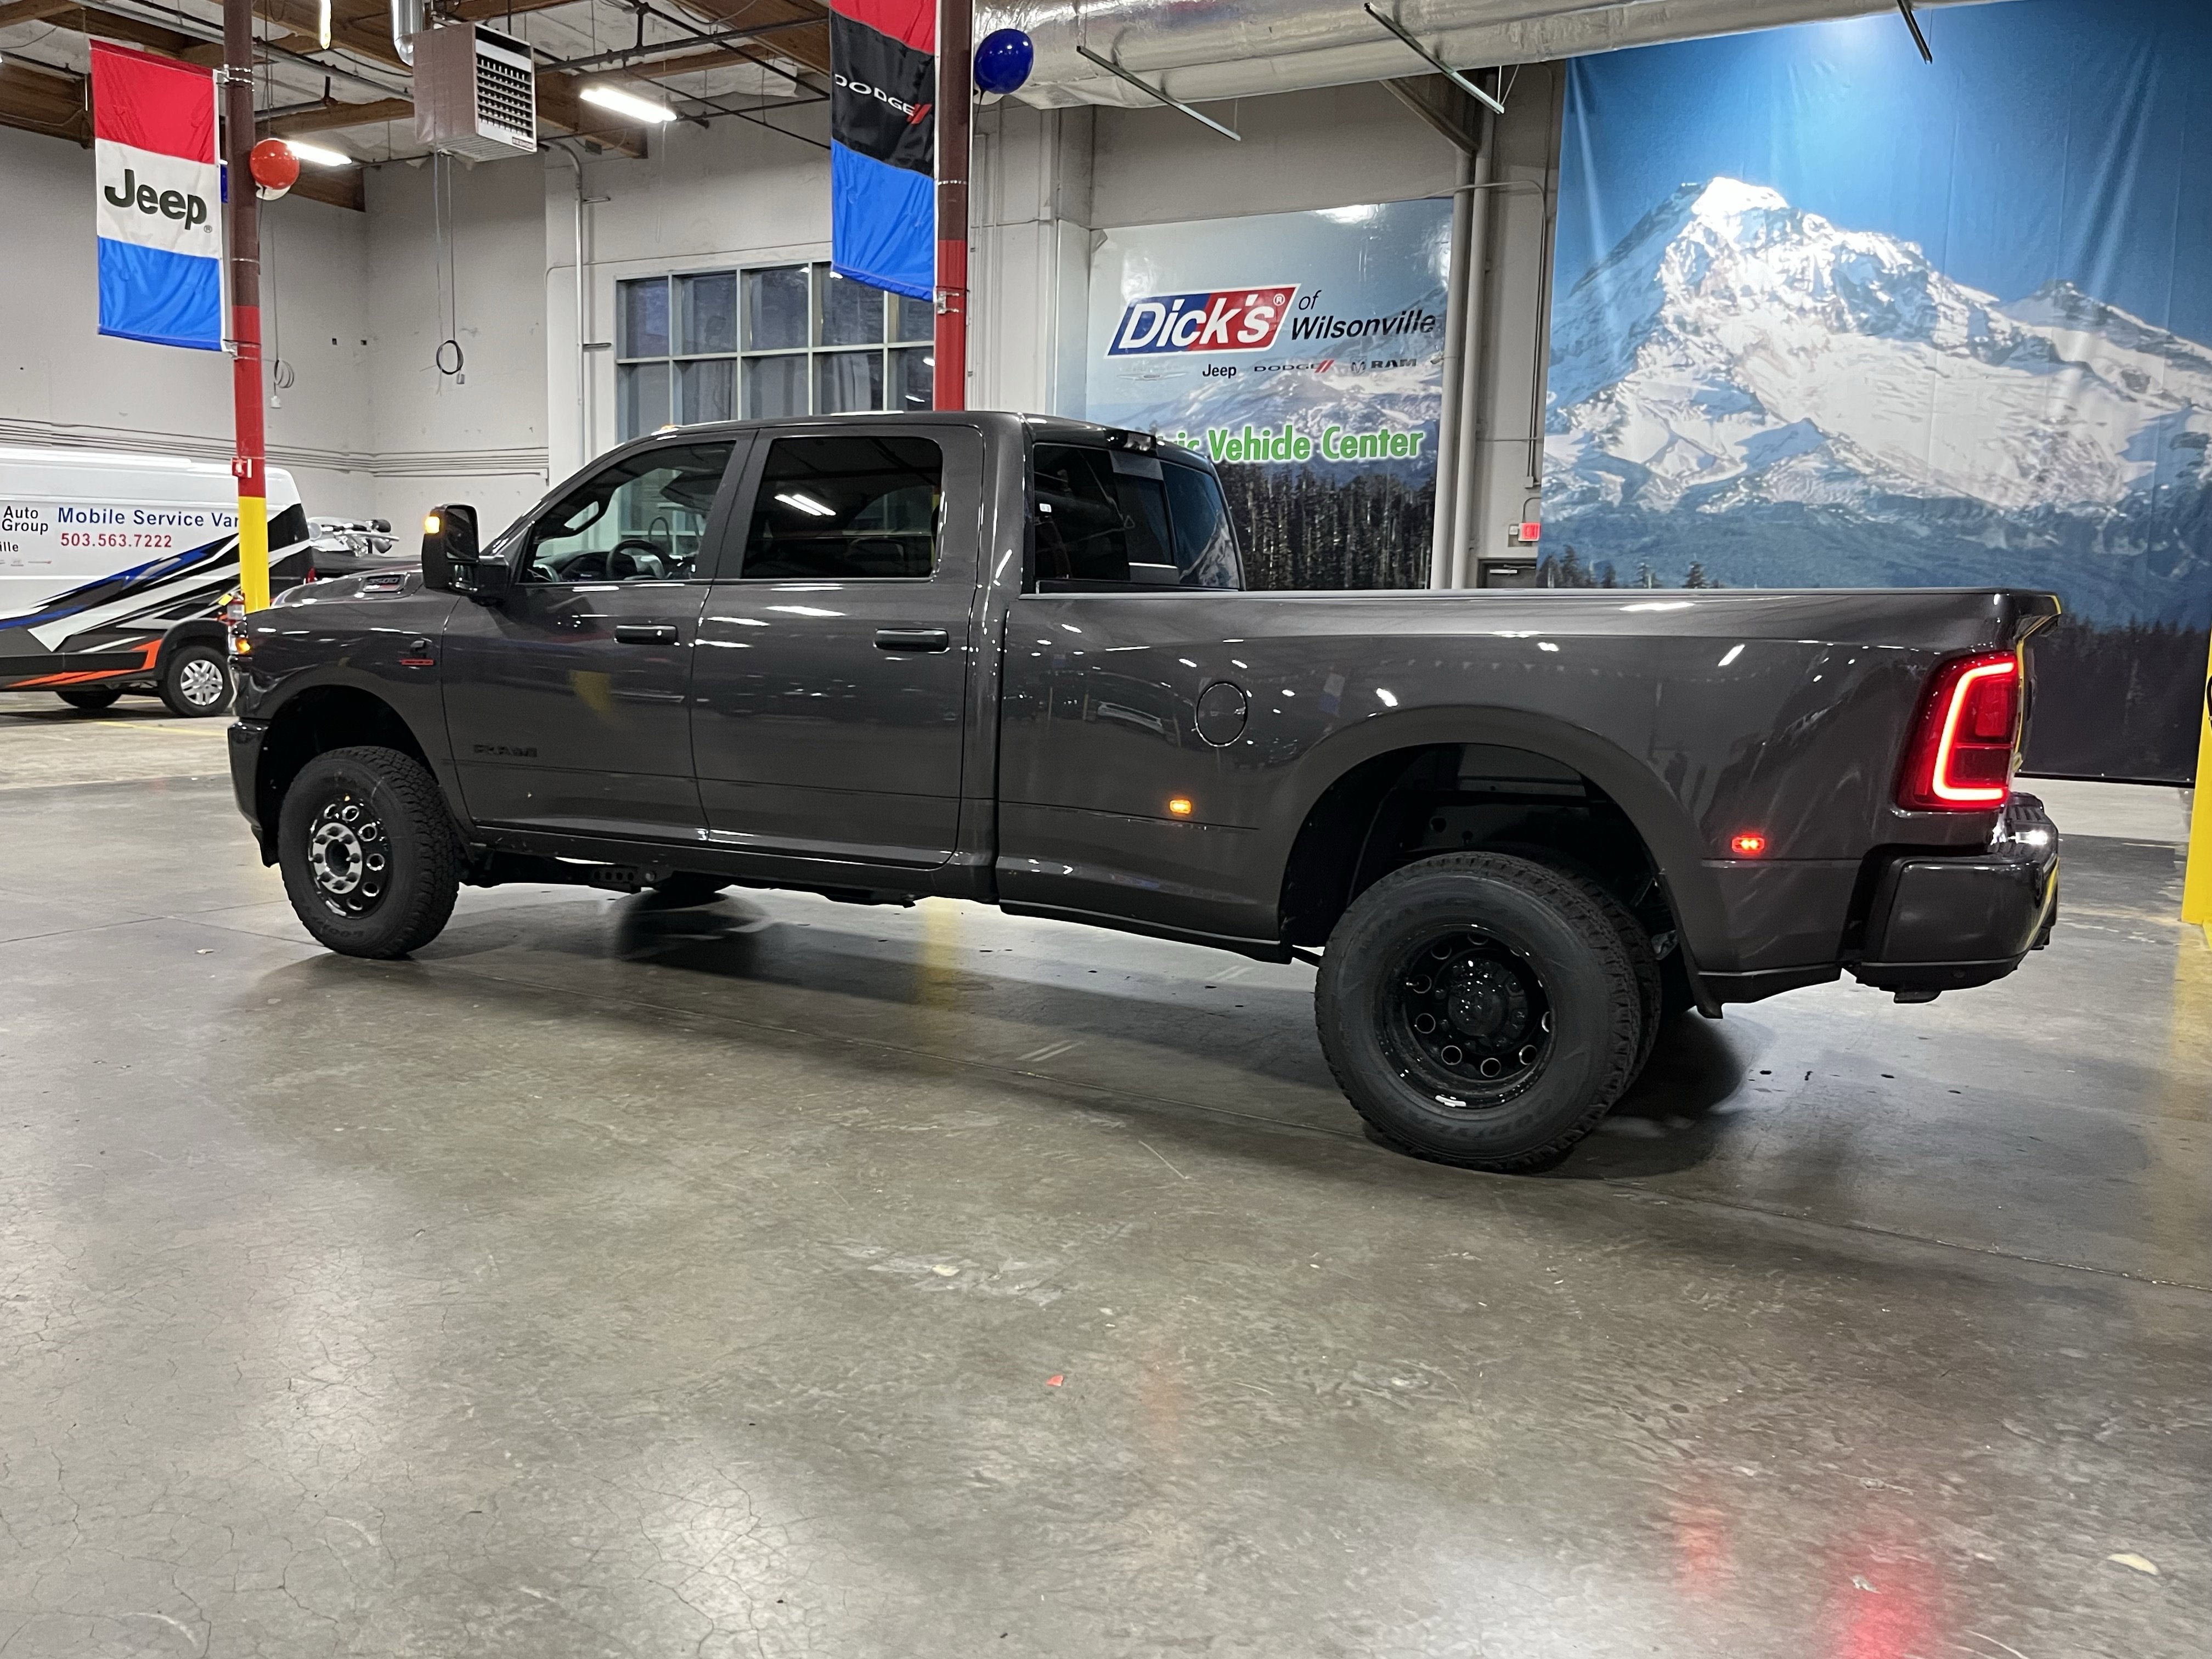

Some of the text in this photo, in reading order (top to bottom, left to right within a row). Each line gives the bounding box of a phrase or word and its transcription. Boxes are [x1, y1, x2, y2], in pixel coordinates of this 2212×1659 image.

[834, 74, 916, 117] DODGE
[104, 169, 207, 230] Jeep
[1298, 290, 1322, 311] of
[1291, 309, 1436, 341] Wilsonville
[1202, 364, 1237, 379] Jeep
[1371, 359, 1417, 369] RAM
[1207, 425, 1311, 461] Vehicle
[1323, 426, 1424, 459] Center
[3, 506, 38, 519] Auto
[58, 507, 126, 524] Mobile
[133, 510, 204, 527] Service
[2, 518, 49, 535] Group
[61, 533, 172, 548] 503.563.7222
